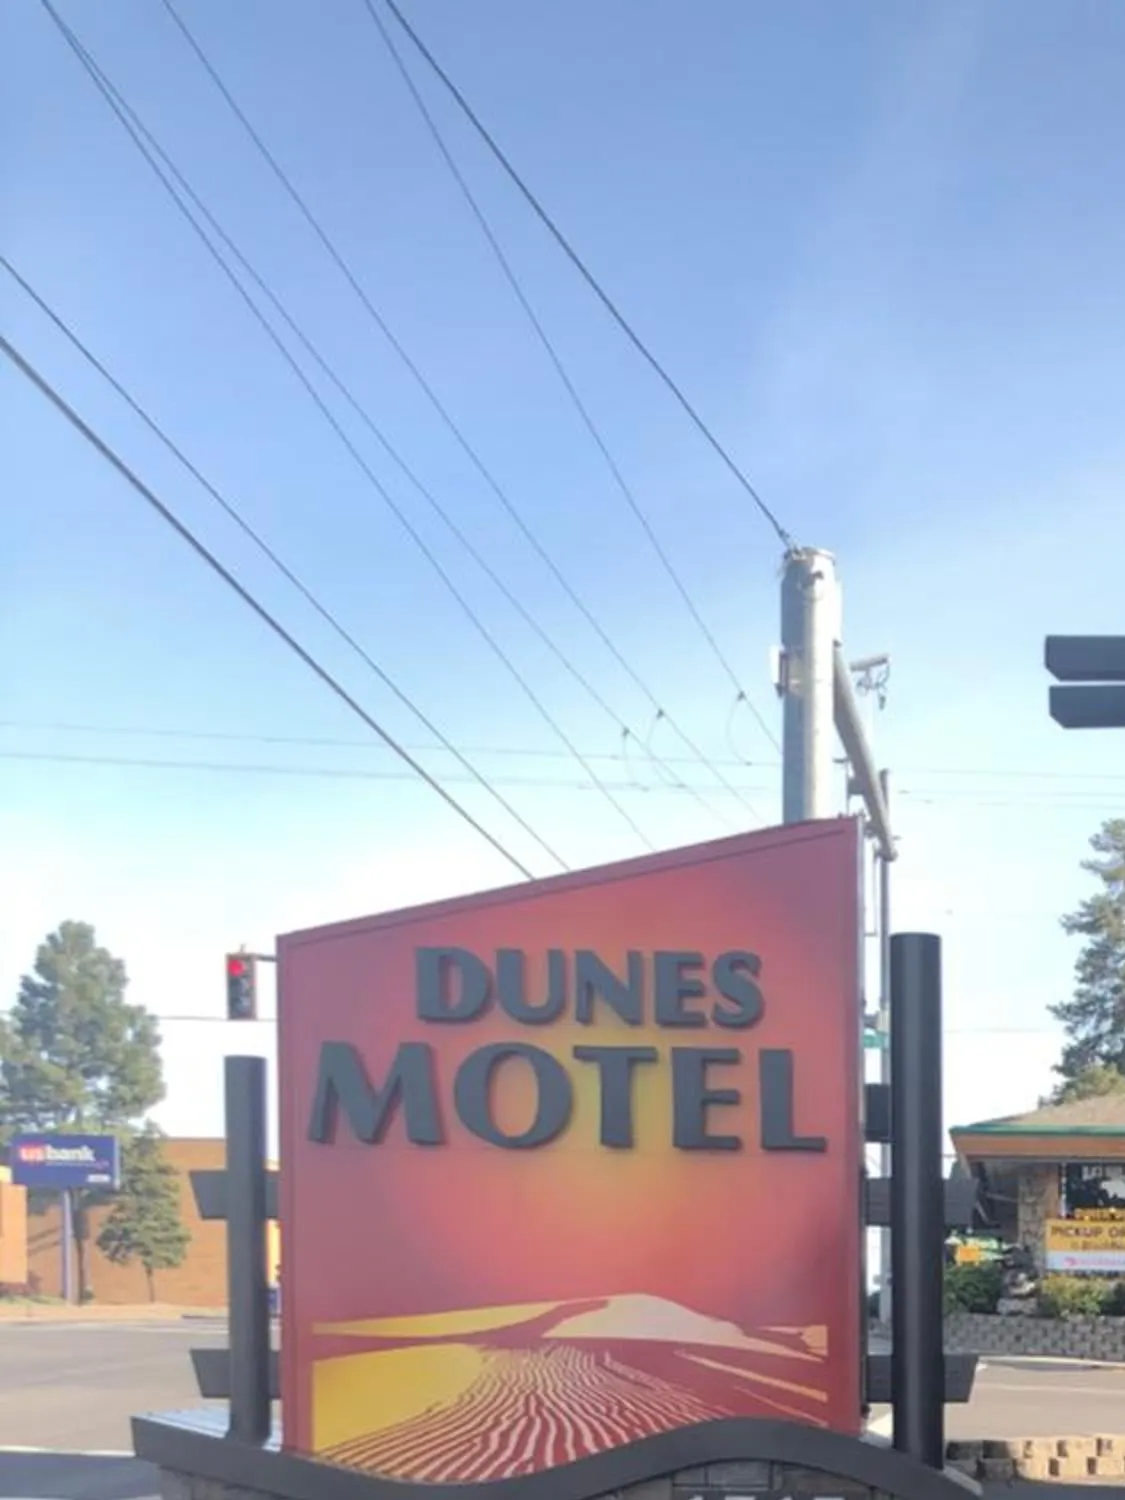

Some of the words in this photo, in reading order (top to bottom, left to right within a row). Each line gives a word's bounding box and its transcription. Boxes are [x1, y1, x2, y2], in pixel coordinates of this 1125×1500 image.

[414, 946, 765, 1029] DUNES
[308, 1041, 828, 1151] MOTEL
[1051, 1225, 1102, 1238] PICKUP
